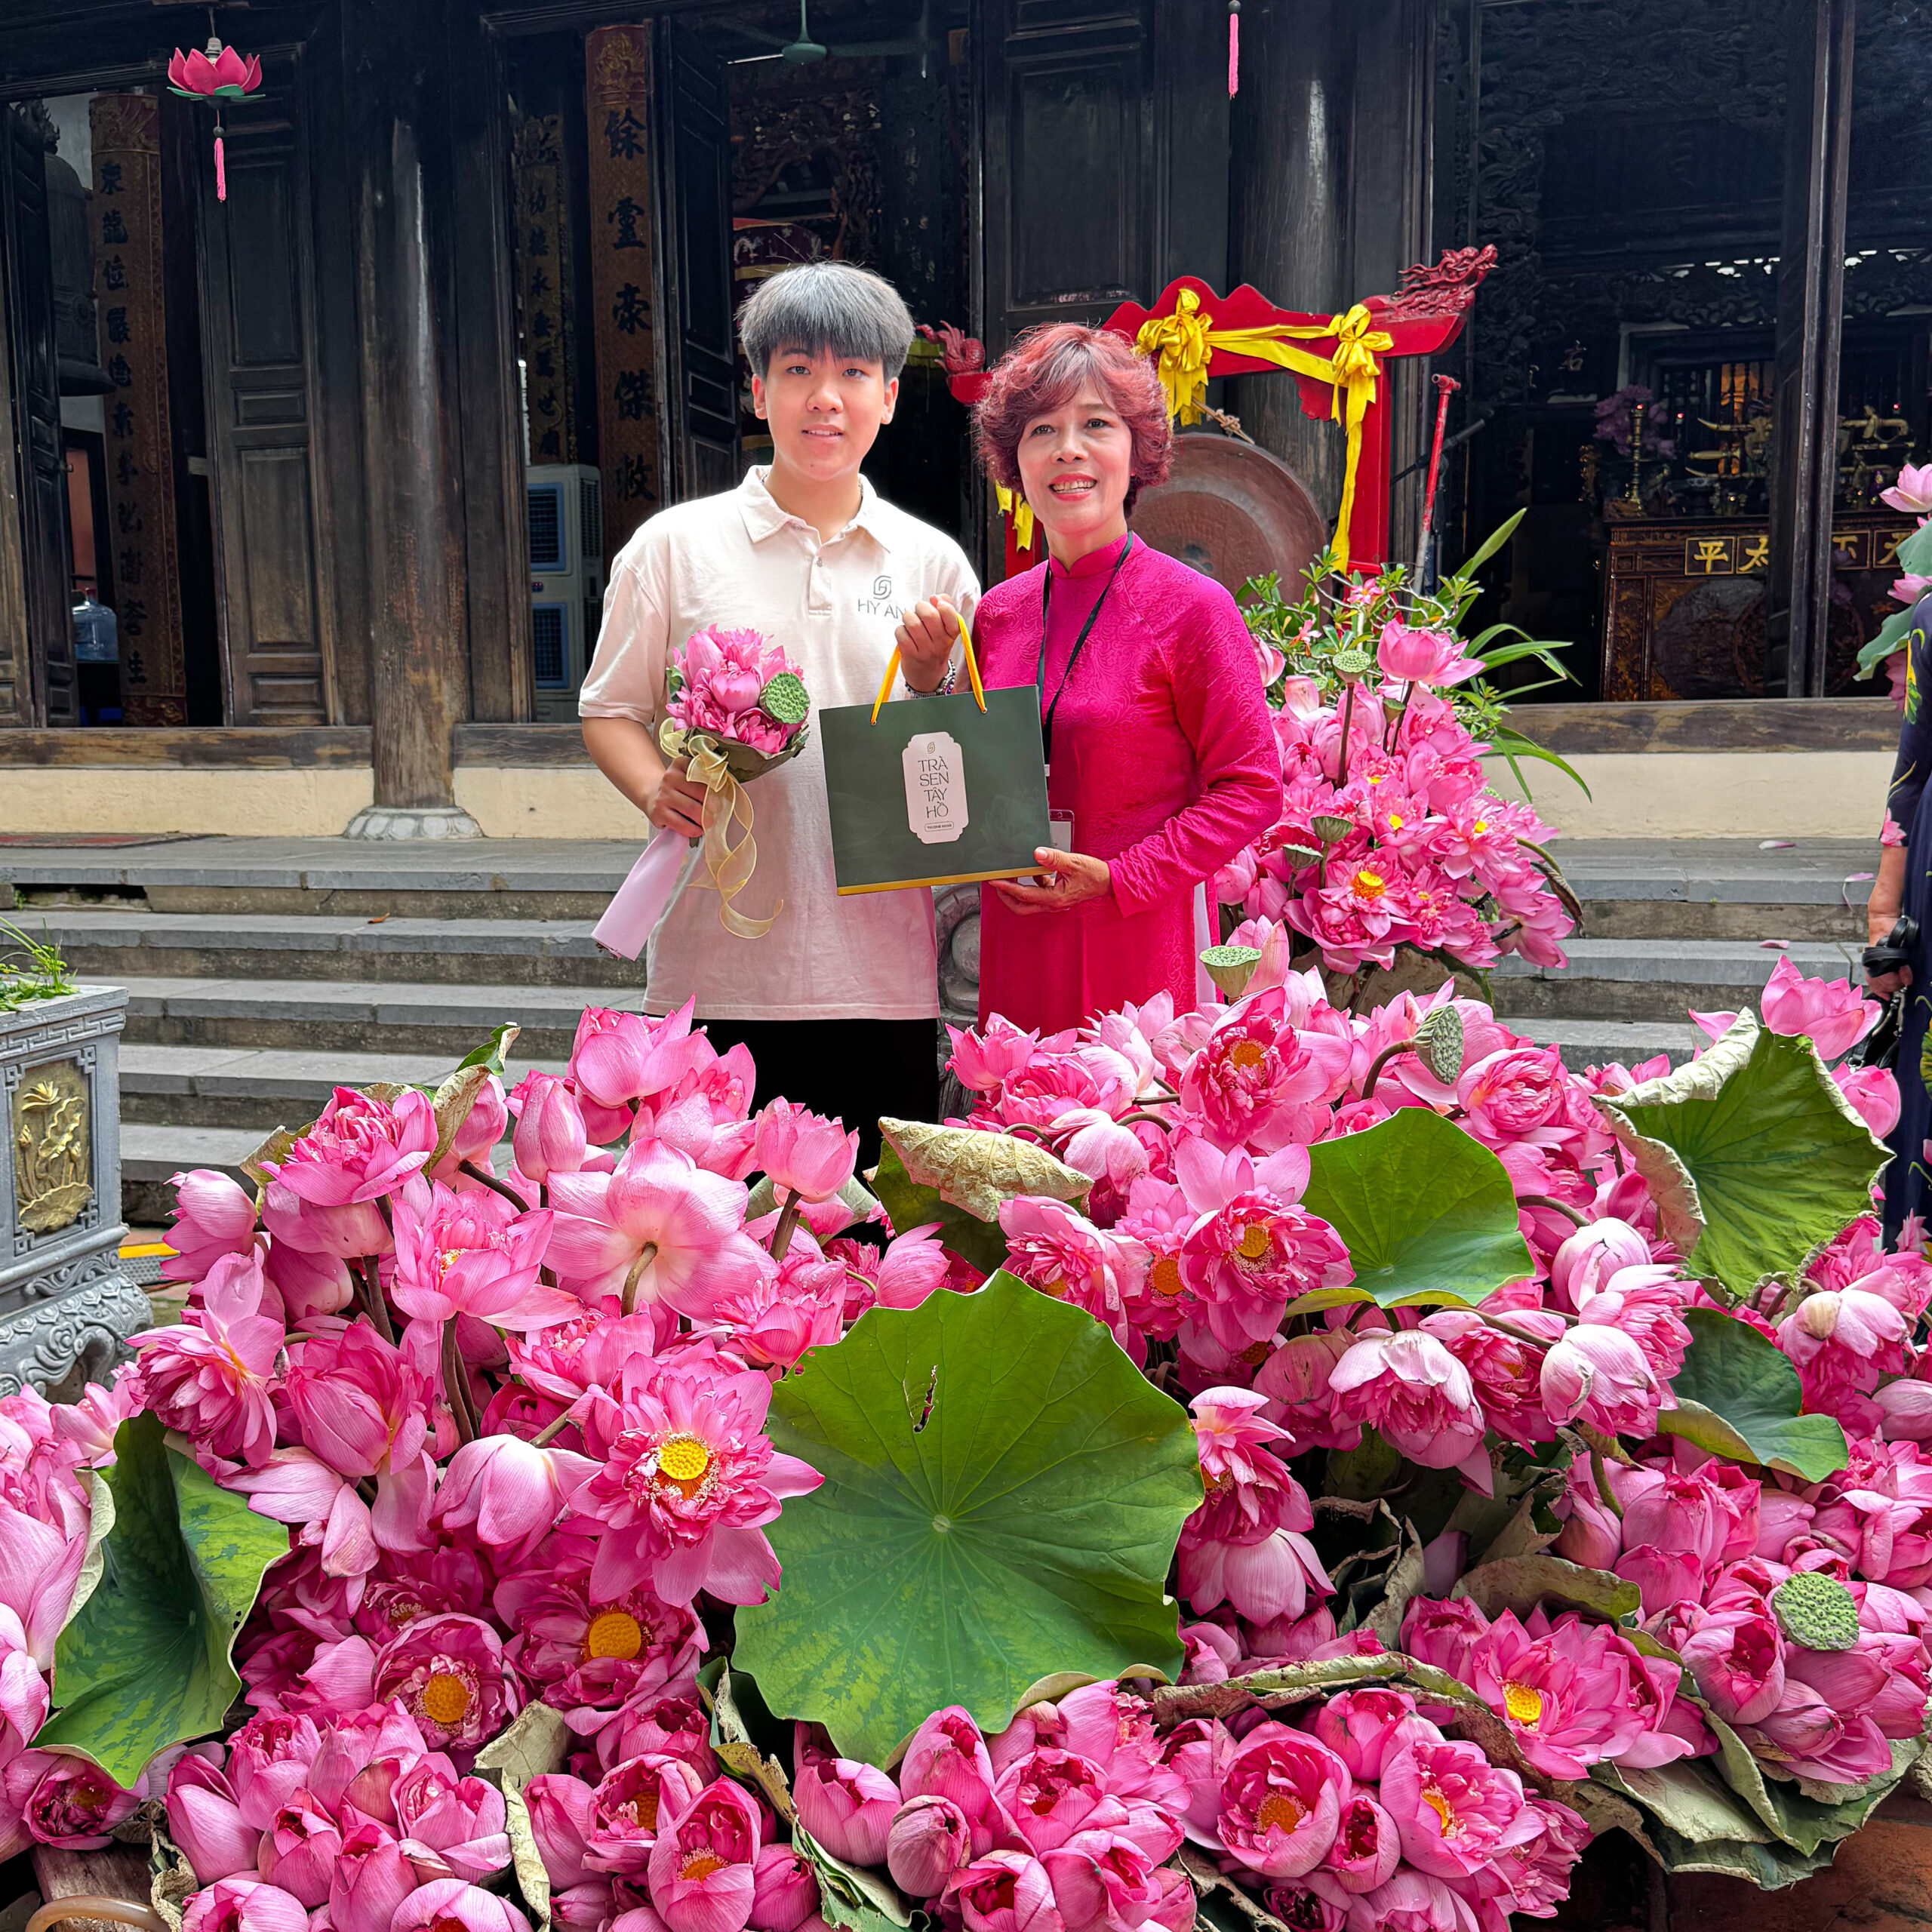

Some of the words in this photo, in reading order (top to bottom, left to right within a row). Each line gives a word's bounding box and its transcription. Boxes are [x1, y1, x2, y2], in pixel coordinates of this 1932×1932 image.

[857, 598, 881, 615] HY
[918, 755, 949, 773] TRÀ
[919, 771, 949, 787] SEN
[924, 786, 948, 802] TÂY
[926, 801, 949, 819] HỒ
